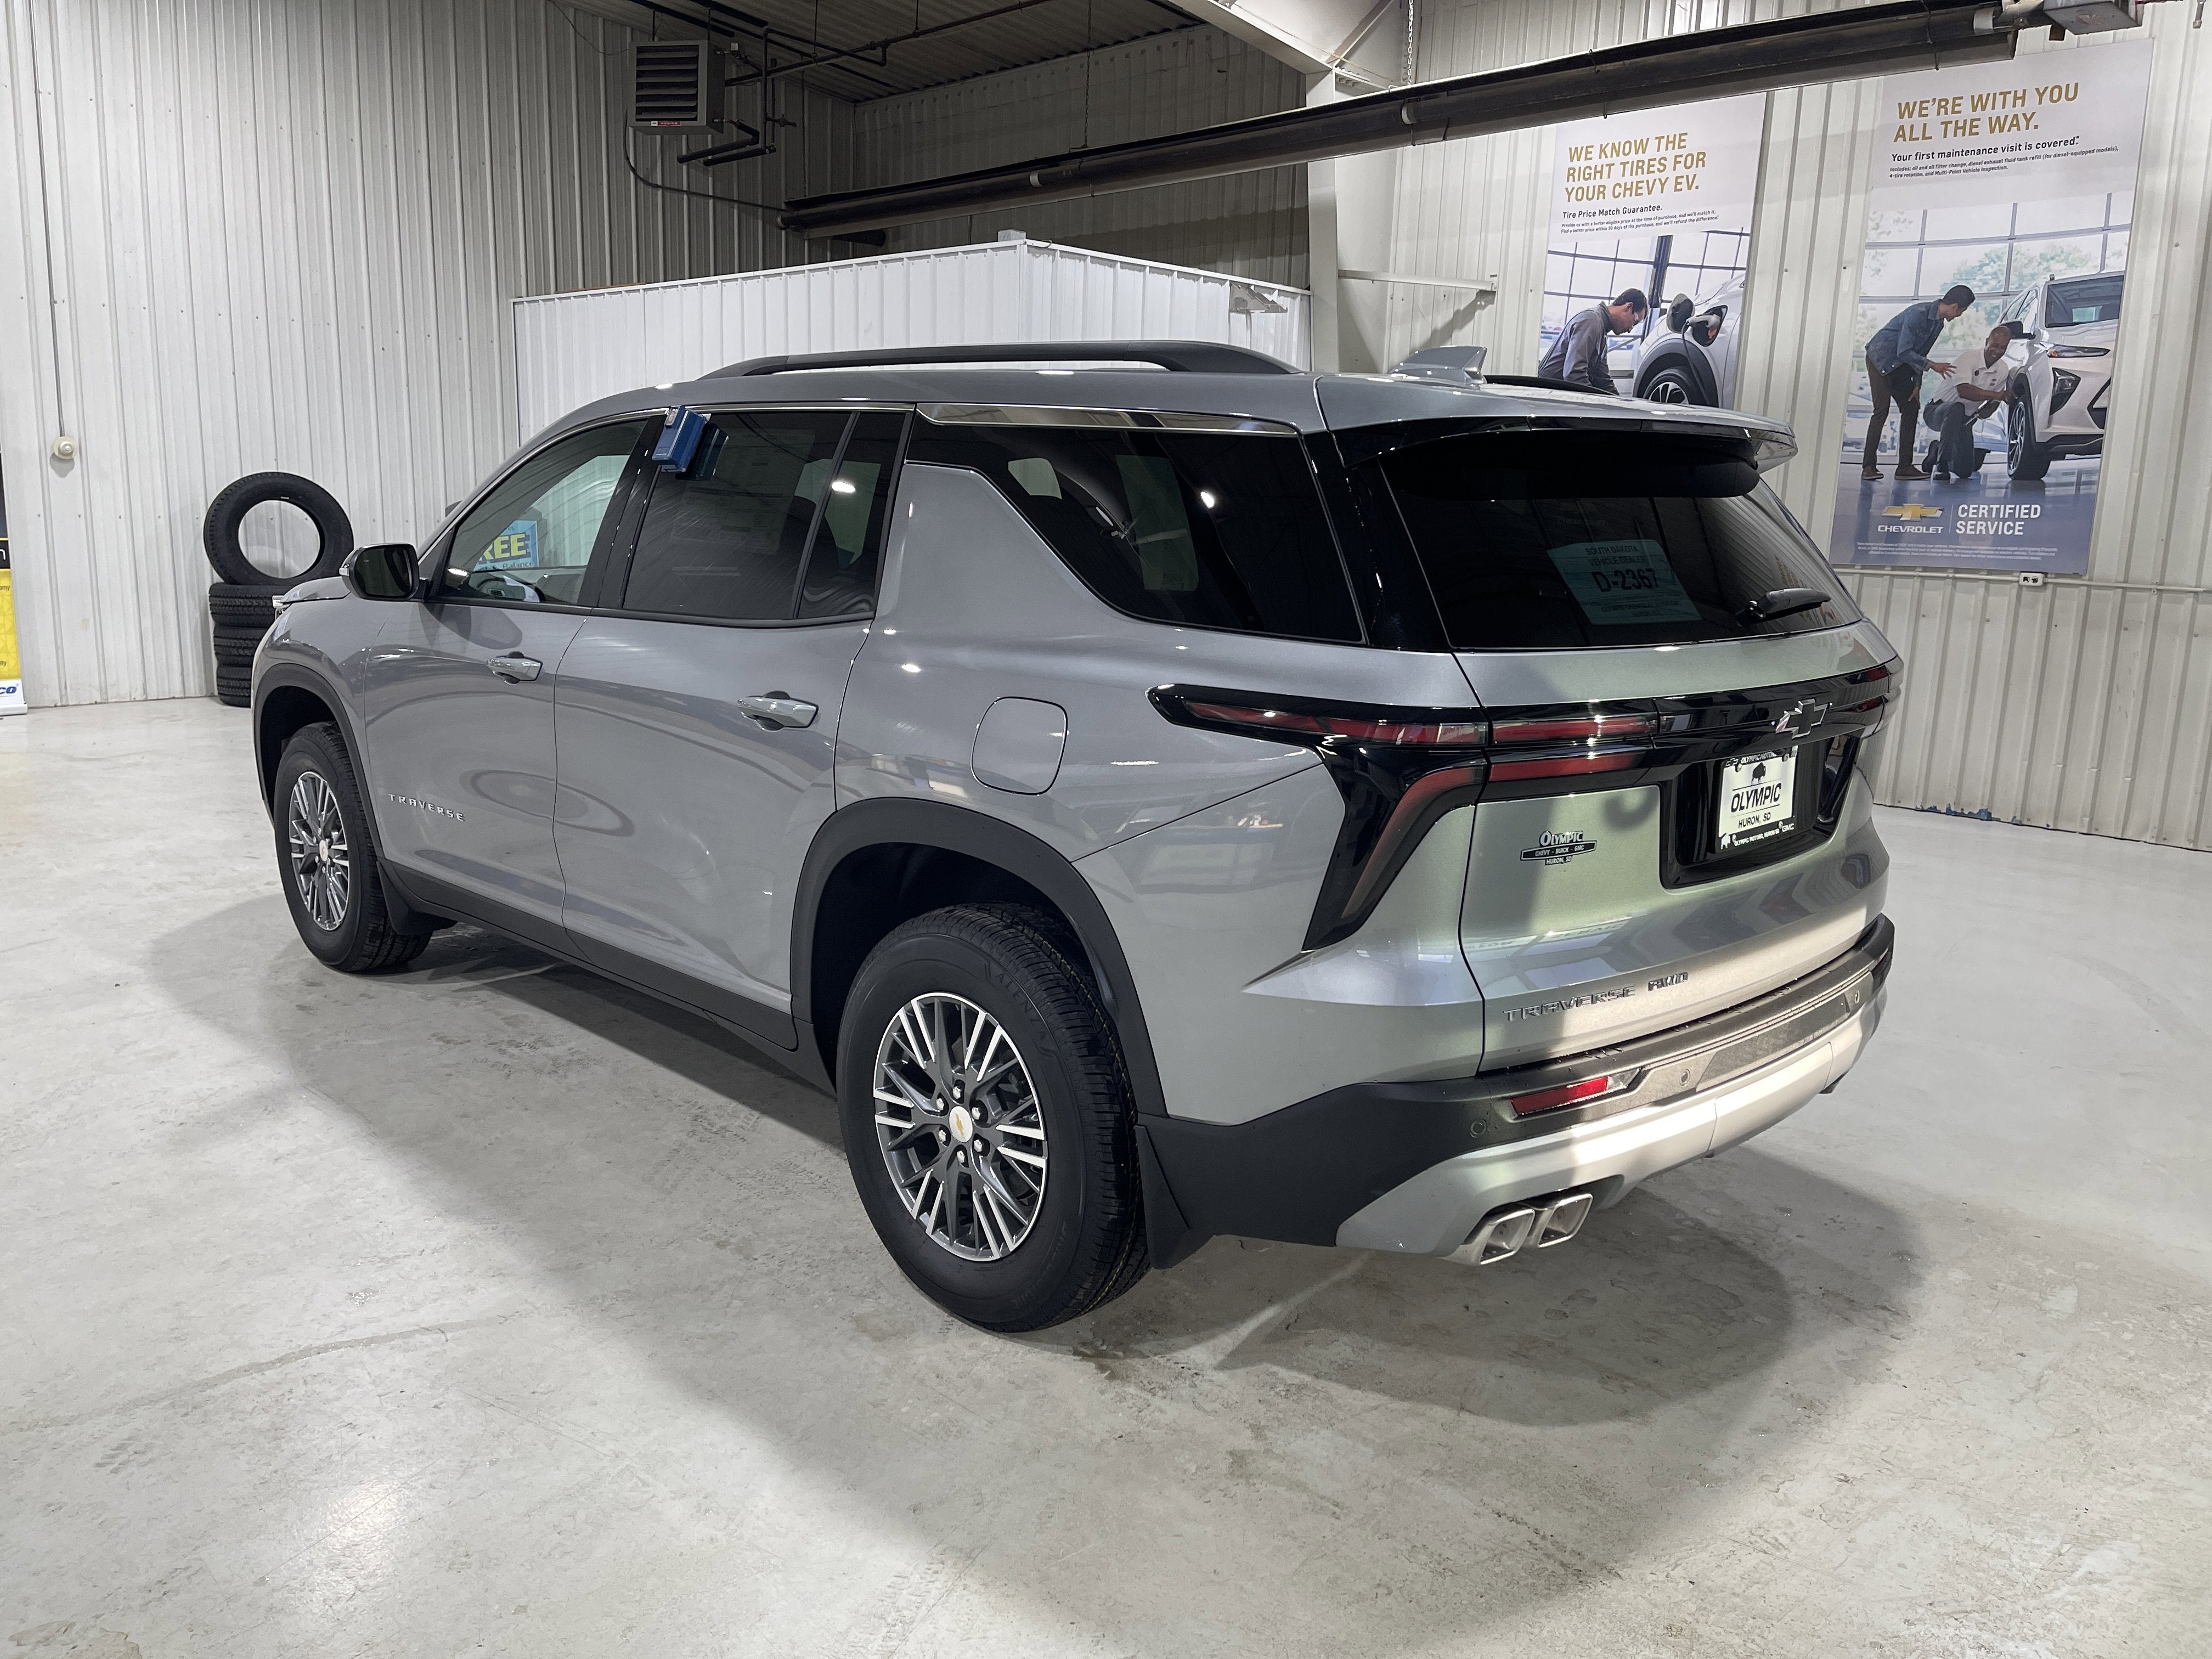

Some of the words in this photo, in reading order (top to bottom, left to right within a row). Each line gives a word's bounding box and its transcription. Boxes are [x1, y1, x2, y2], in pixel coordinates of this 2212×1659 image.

[1898, 96, 1963, 120] WE'RE
[1970, 89, 2027, 112] WITH
[2035, 82, 2079, 105] YOU
[1893, 123, 1933, 143] ALL
[1940, 118, 1981, 139] THE
[1988, 111, 2039, 134] WAY.
[1568, 145, 1594, 162] WE
[1599, 138, 1650, 159] KNOW
[1655, 132, 1689, 152] THE
[1915, 151, 1934, 160] first
[1938, 147, 1998, 159] maintenance
[2001, 143, 2022, 153] visit
[2024, 142, 2033, 150] is
[2053, 149, 2095, 157] diesel-equipped
[1566, 163, 1615, 183] RIGHT
[1620, 157, 1667, 178] TIRES
[1673, 151, 1706, 171] FOR
[1565, 184, 1606, 202] YOUR
[1612, 177, 1669, 199] CHEVY
[1674, 173, 1699, 193] EV.
[1578, 210, 1596, 218] Price
[1598, 207, 1620, 216] Match
[1622, 205, 1662, 214] Guarantee.
[1957, 504, 2041, 519] CERTIFIED
[1877, 524, 1944, 534] CHEVROLET
[1955, 521, 2024, 536] SERVICE
[1585, 546, 1610, 556] SOUTH
[1612, 545, 1638, 554] DAKOTA
[1588, 558, 1618, 566] VEHICLE
[1620, 556, 1646, 565] DEALER
[1591, 568, 1659, 592] D-2367
[1731, 782, 1782, 813] OLYMPIC
[388, 793, 465, 822] TRAVERSE
[1738, 815, 1761, 828] HURON,
[1763, 812, 1771, 822] SD
[1782, 823, 1795, 832] GMC
[1502, 985, 1636, 1022] TRAVERSE
[1648, 972, 1689, 991] AWD
